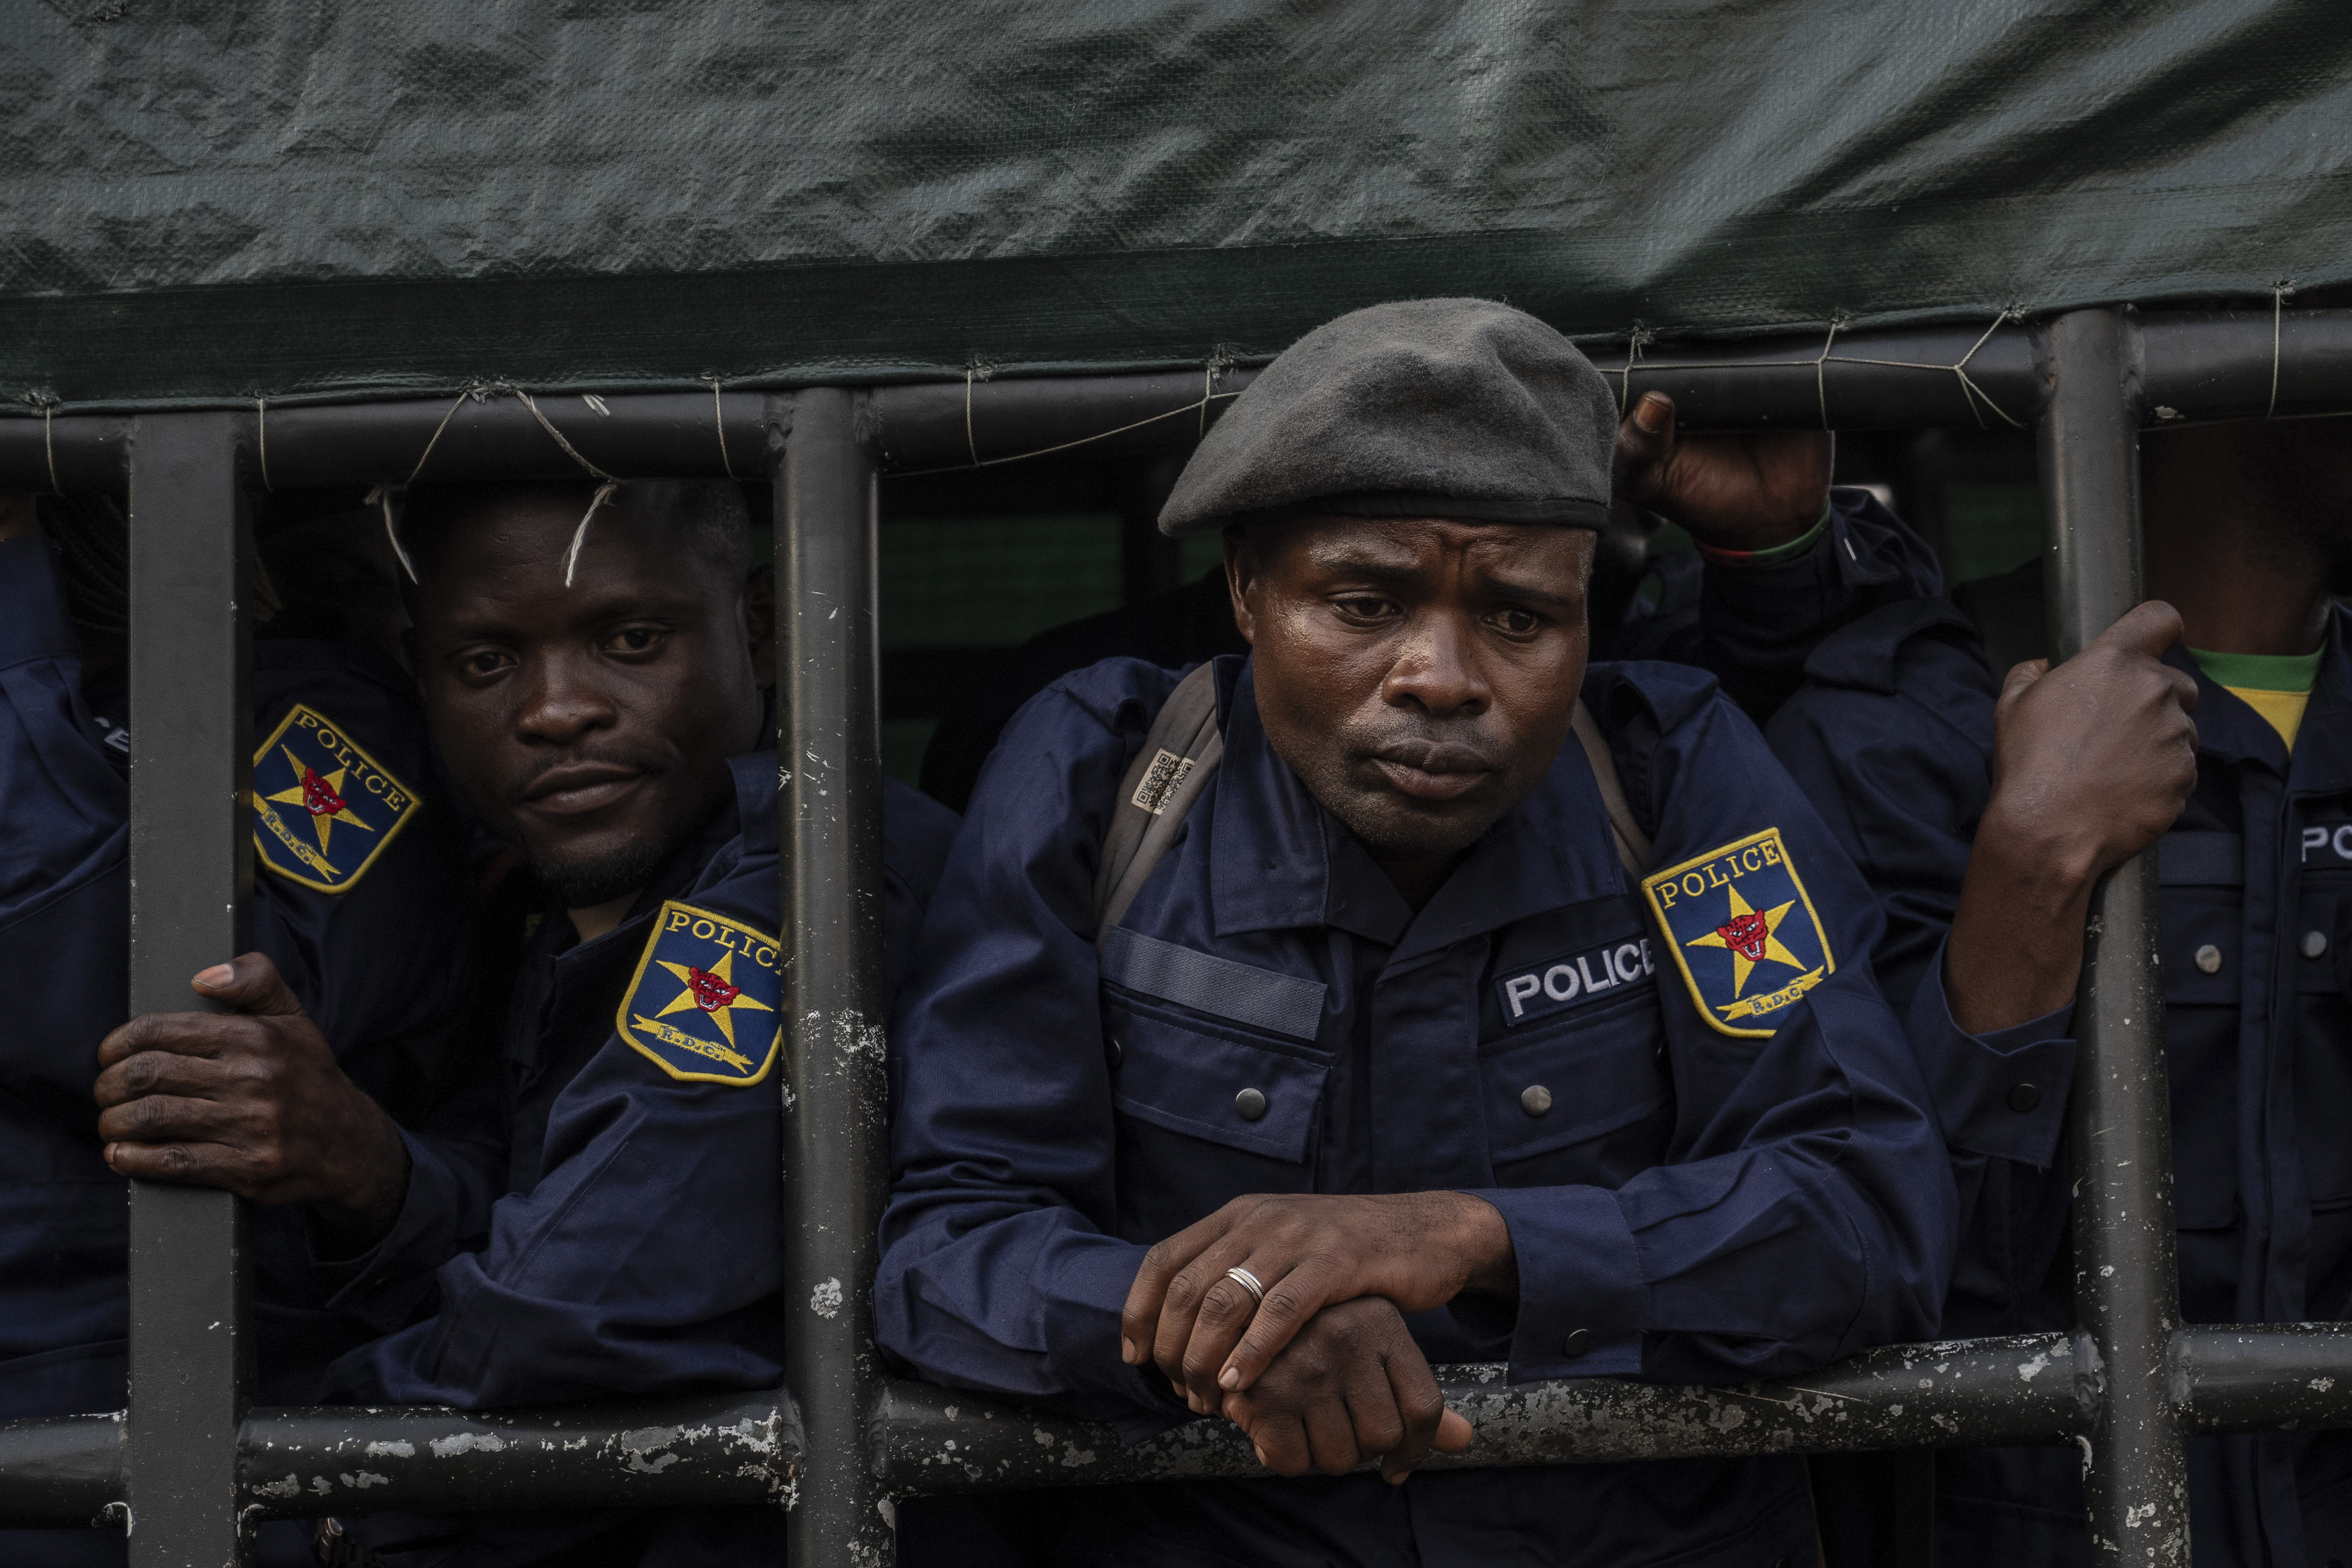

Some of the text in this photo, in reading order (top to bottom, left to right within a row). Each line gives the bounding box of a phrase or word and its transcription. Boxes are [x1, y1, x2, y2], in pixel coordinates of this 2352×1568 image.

[295, 712, 405, 812] POLICE
[1656, 839, 1781, 910] POLICE
[665, 911, 781, 976] POLIC
